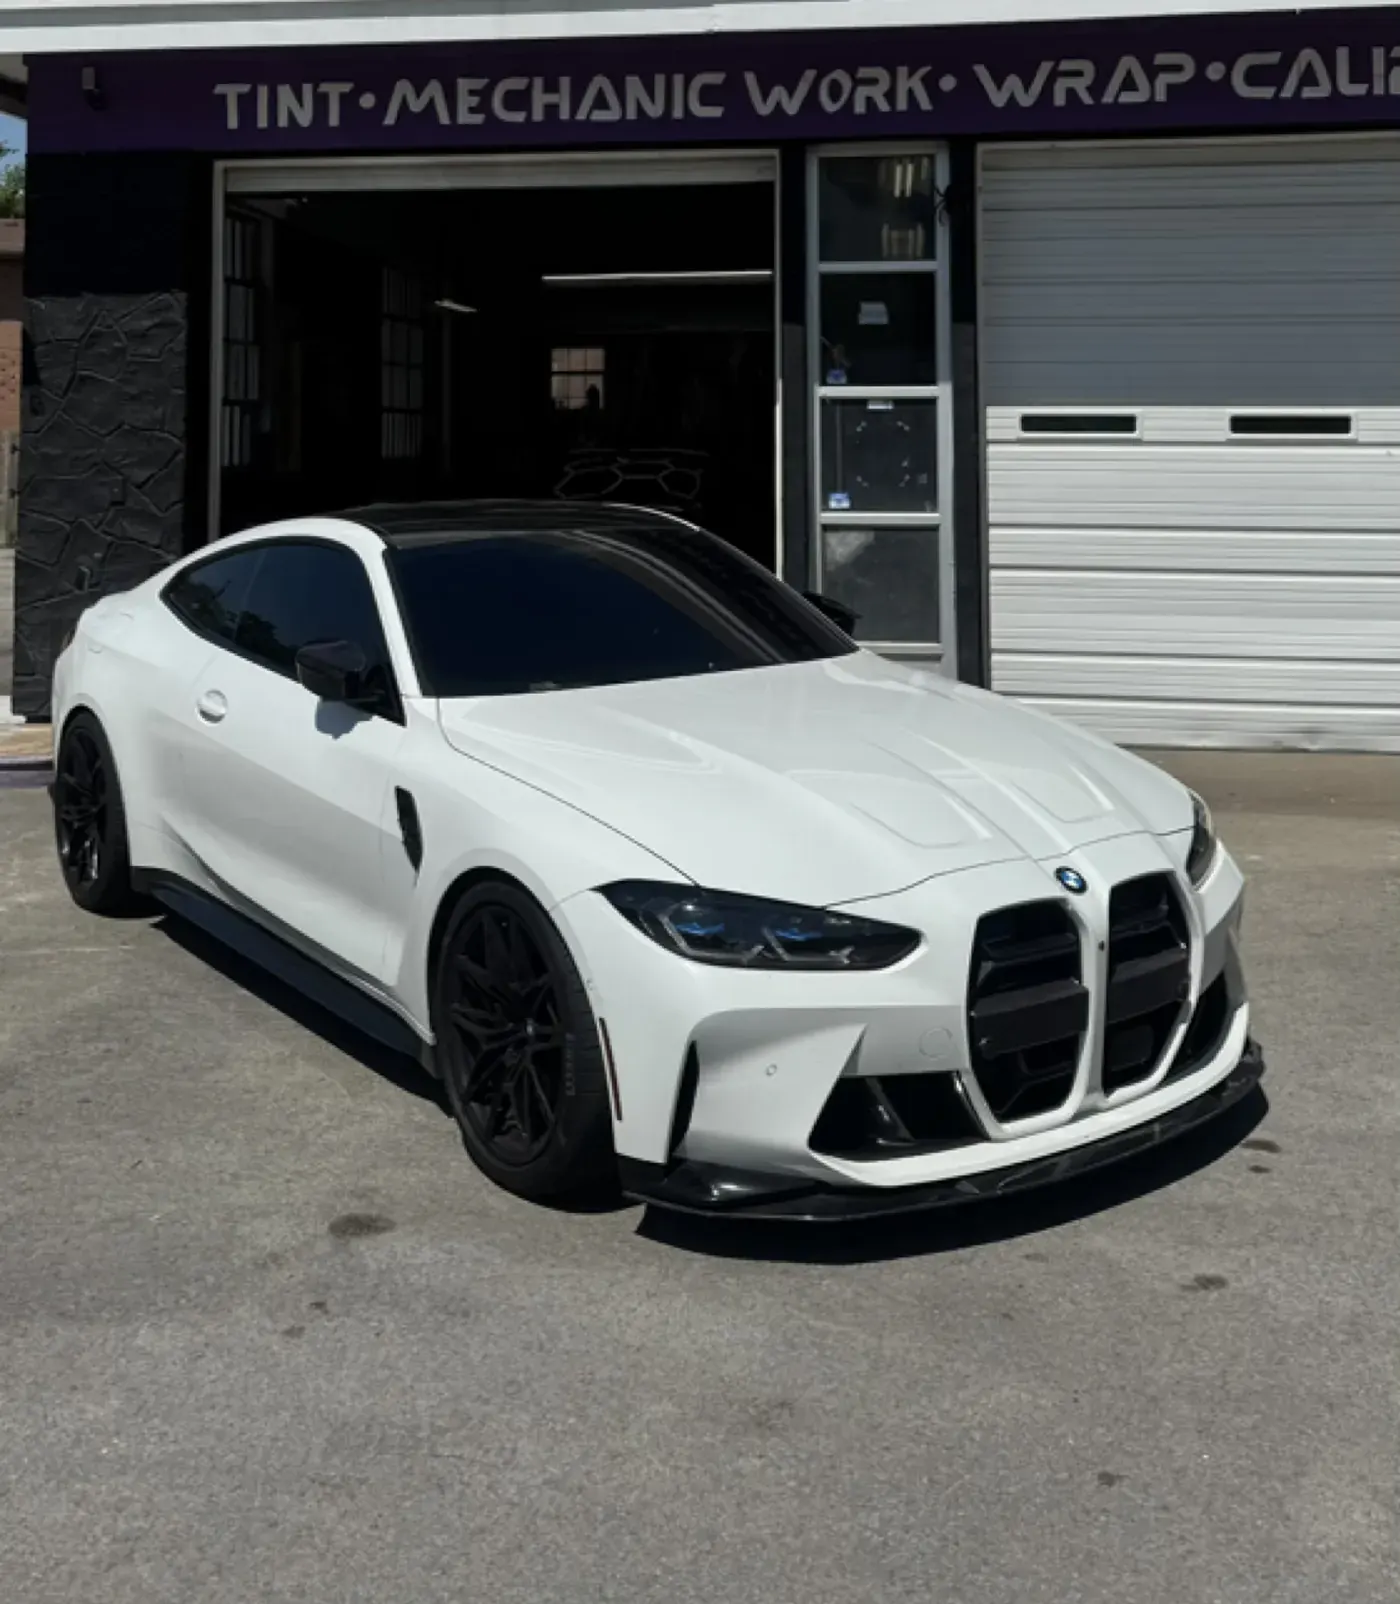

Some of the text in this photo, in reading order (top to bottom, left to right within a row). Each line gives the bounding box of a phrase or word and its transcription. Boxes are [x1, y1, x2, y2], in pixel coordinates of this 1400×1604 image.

[213, 82, 353, 130] TINT
[382, 73, 726, 126] MECHANIC
[744, 66, 933, 115] WORK
[973, 53, 1194, 108] WRAP
